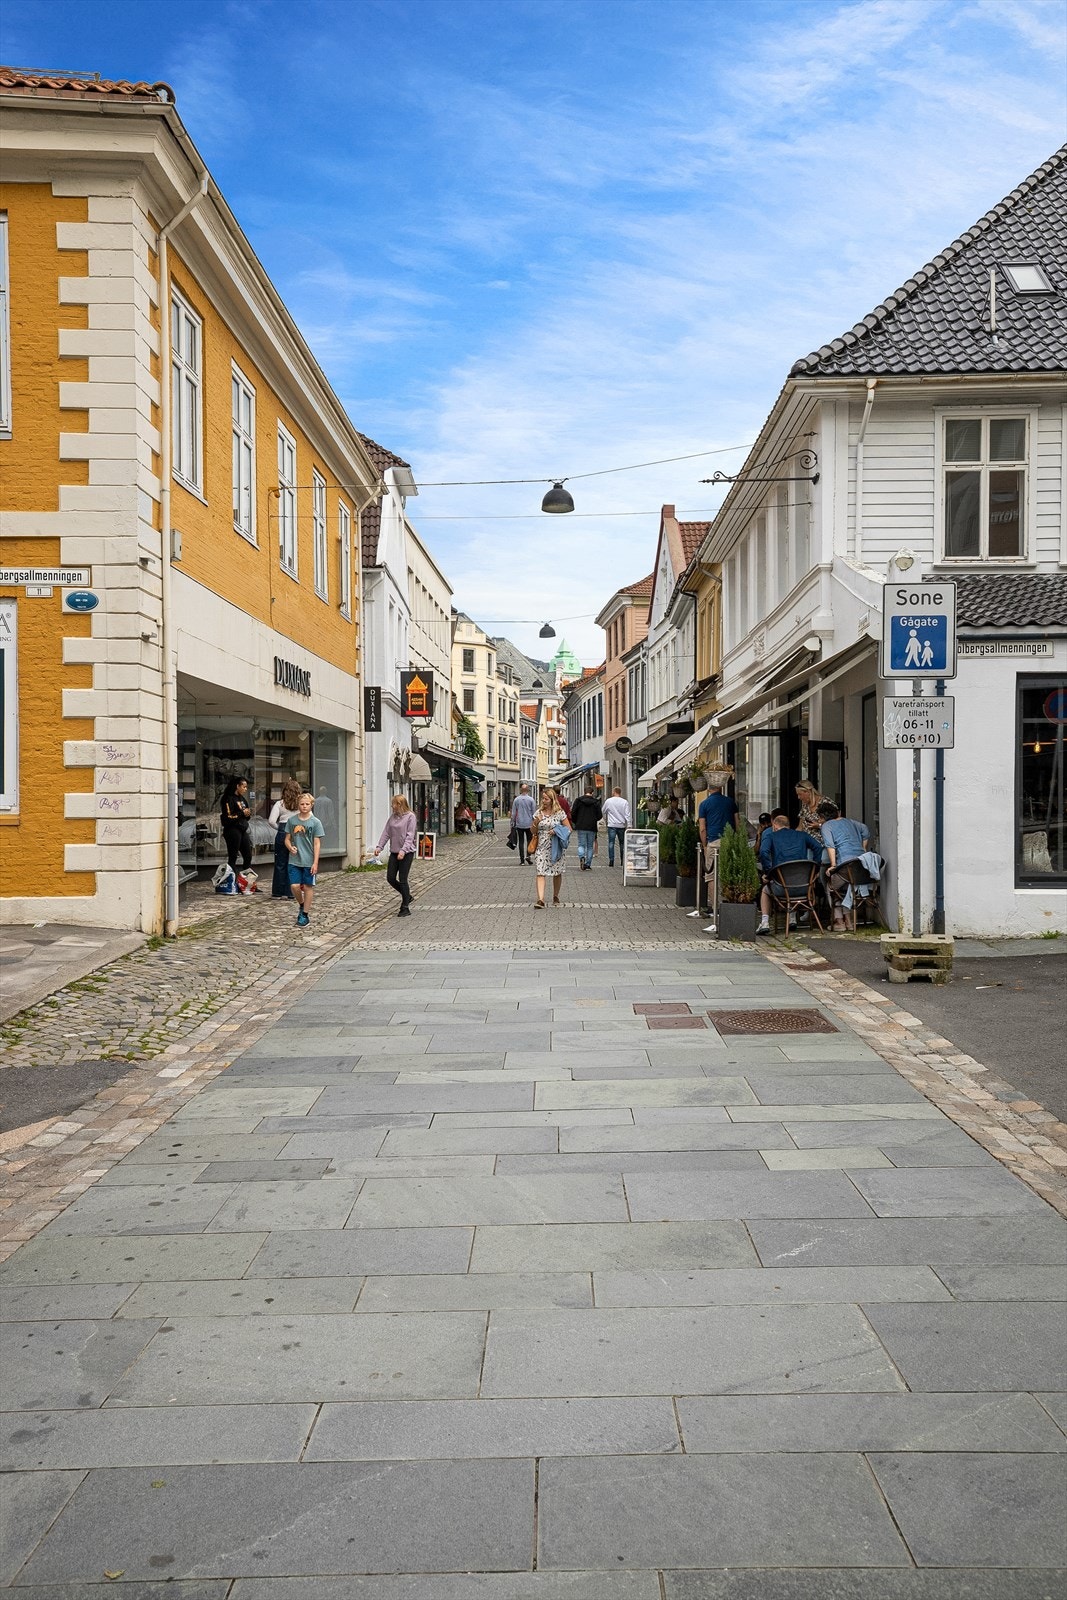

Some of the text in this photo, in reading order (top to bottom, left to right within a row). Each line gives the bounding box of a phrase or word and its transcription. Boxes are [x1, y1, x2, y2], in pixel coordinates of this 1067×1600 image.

[0, 569, 82, 584] bergsallmenningen
[896, 589, 943, 606] Sone
[900, 616, 938, 629] Gågate
[957, 642, 1047, 656] olbergsallmenningen
[893, 700, 945, 709] Varetransport
[908, 709, 929, 717] tillatt
[903, 719, 934, 729] 06-11
